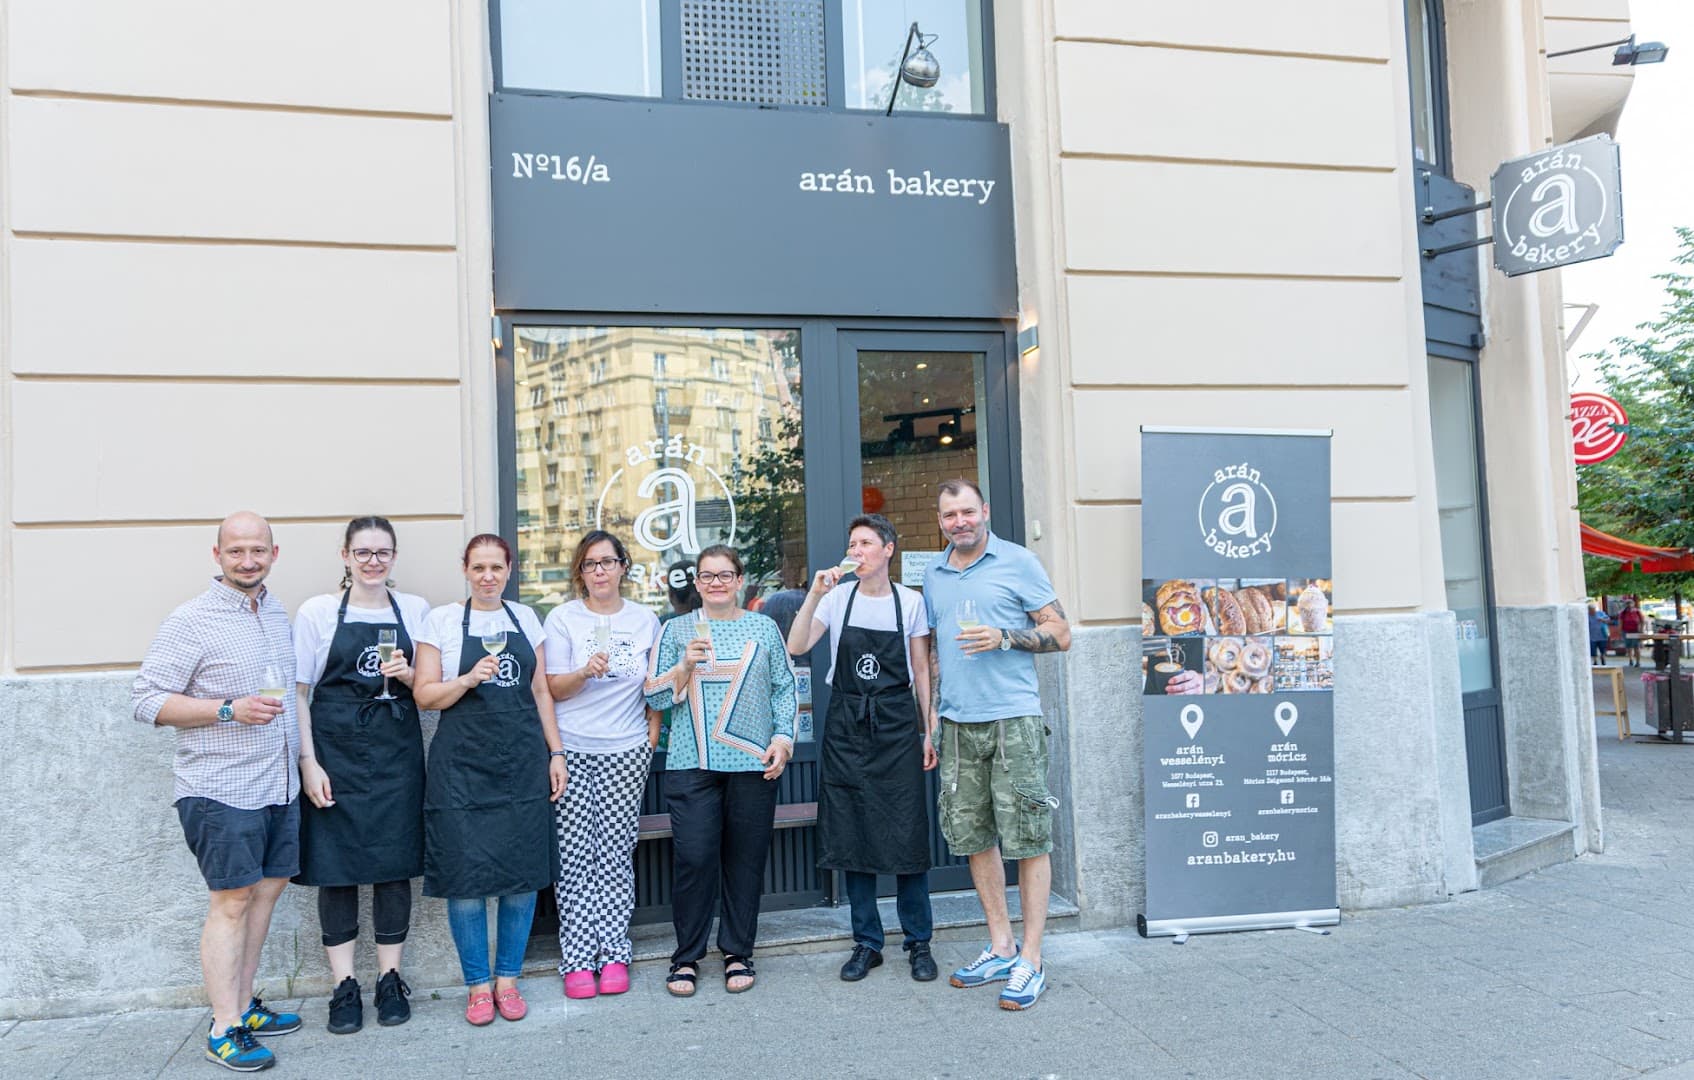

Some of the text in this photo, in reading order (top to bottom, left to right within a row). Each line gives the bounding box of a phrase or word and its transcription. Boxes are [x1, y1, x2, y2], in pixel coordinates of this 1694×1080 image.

[1521, 150, 1582, 183] arán
[799, 168, 996, 205] arán bakery
[1528, 173, 1580, 238] a
[1511, 222, 1601, 264] bakery
[626, 433, 705, 467] arán
[1214, 462, 1261, 484] arán
[633, 467, 701, 555] a
[1218, 482, 1258, 539] a
[1204, 528, 1273, 559] bakery
[1160, 754, 1226, 767] wesselényi
[1176, 744, 1205, 755] arán
[1267, 751, 1307, 763] móricz
[1270, 742, 1298, 752] arán
[1225, 832, 1280, 843] aran_bakery
[1187, 849, 1296, 866] aranbakery.hu
